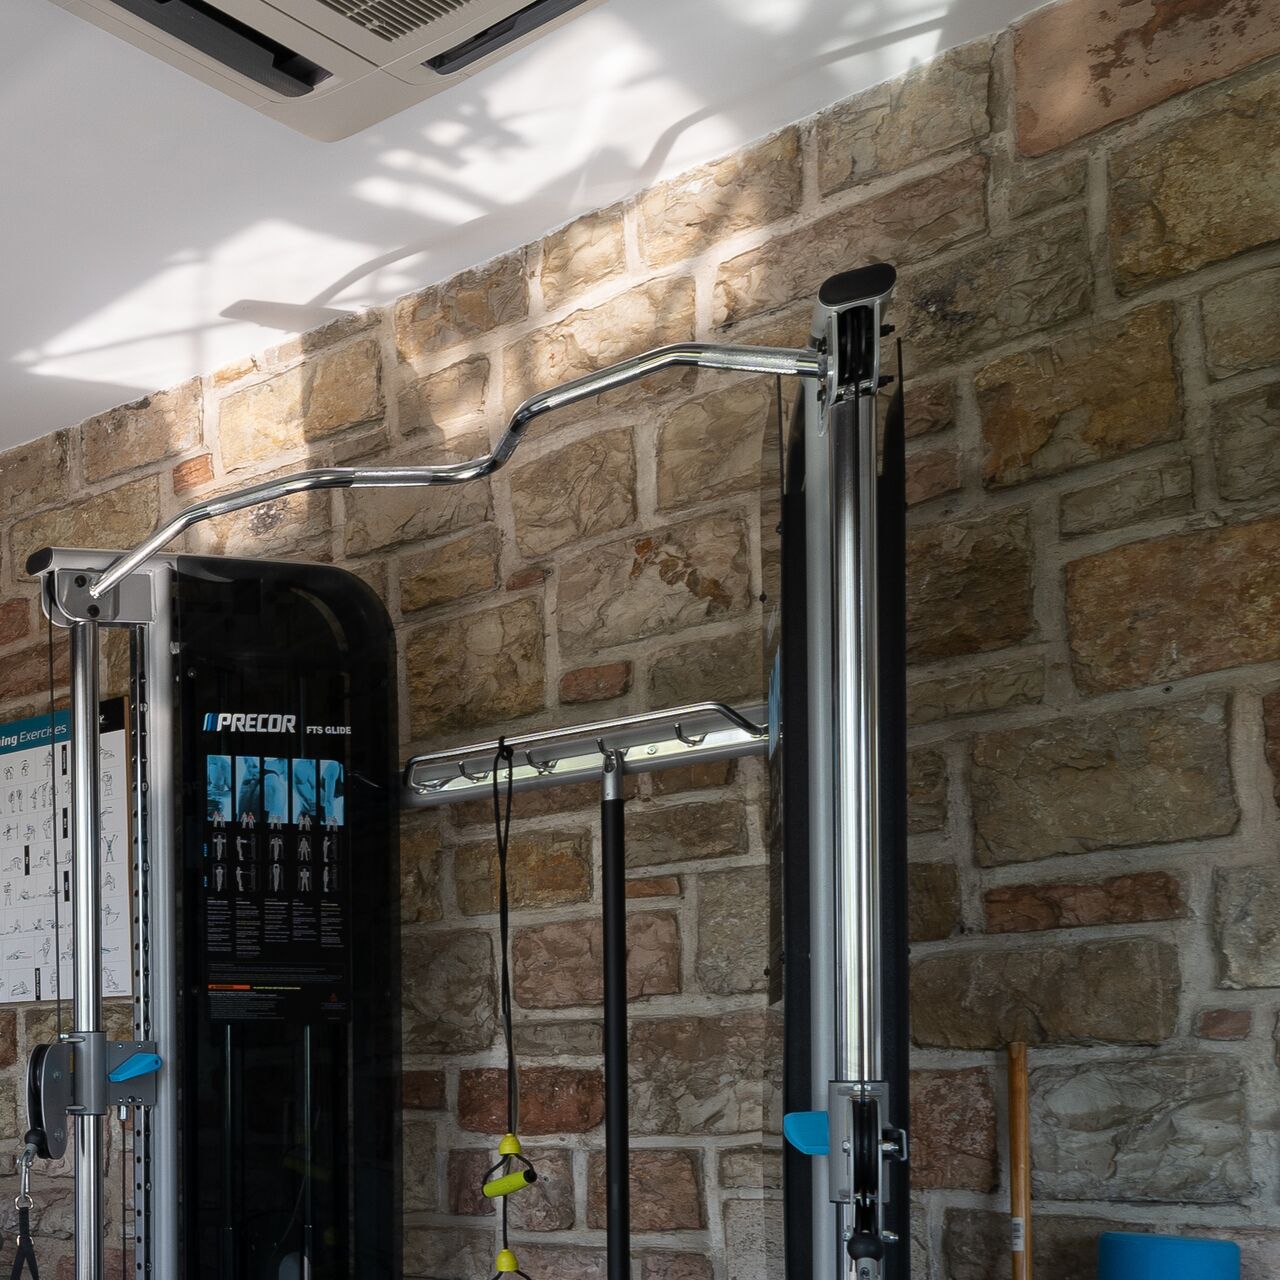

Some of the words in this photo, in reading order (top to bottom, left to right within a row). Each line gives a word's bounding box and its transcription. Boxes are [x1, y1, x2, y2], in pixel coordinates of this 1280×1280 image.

[216, 713, 296, 733] PRECOR
[306, 726, 323, 734] FTS
[325, 726, 352, 735] GLIDE
